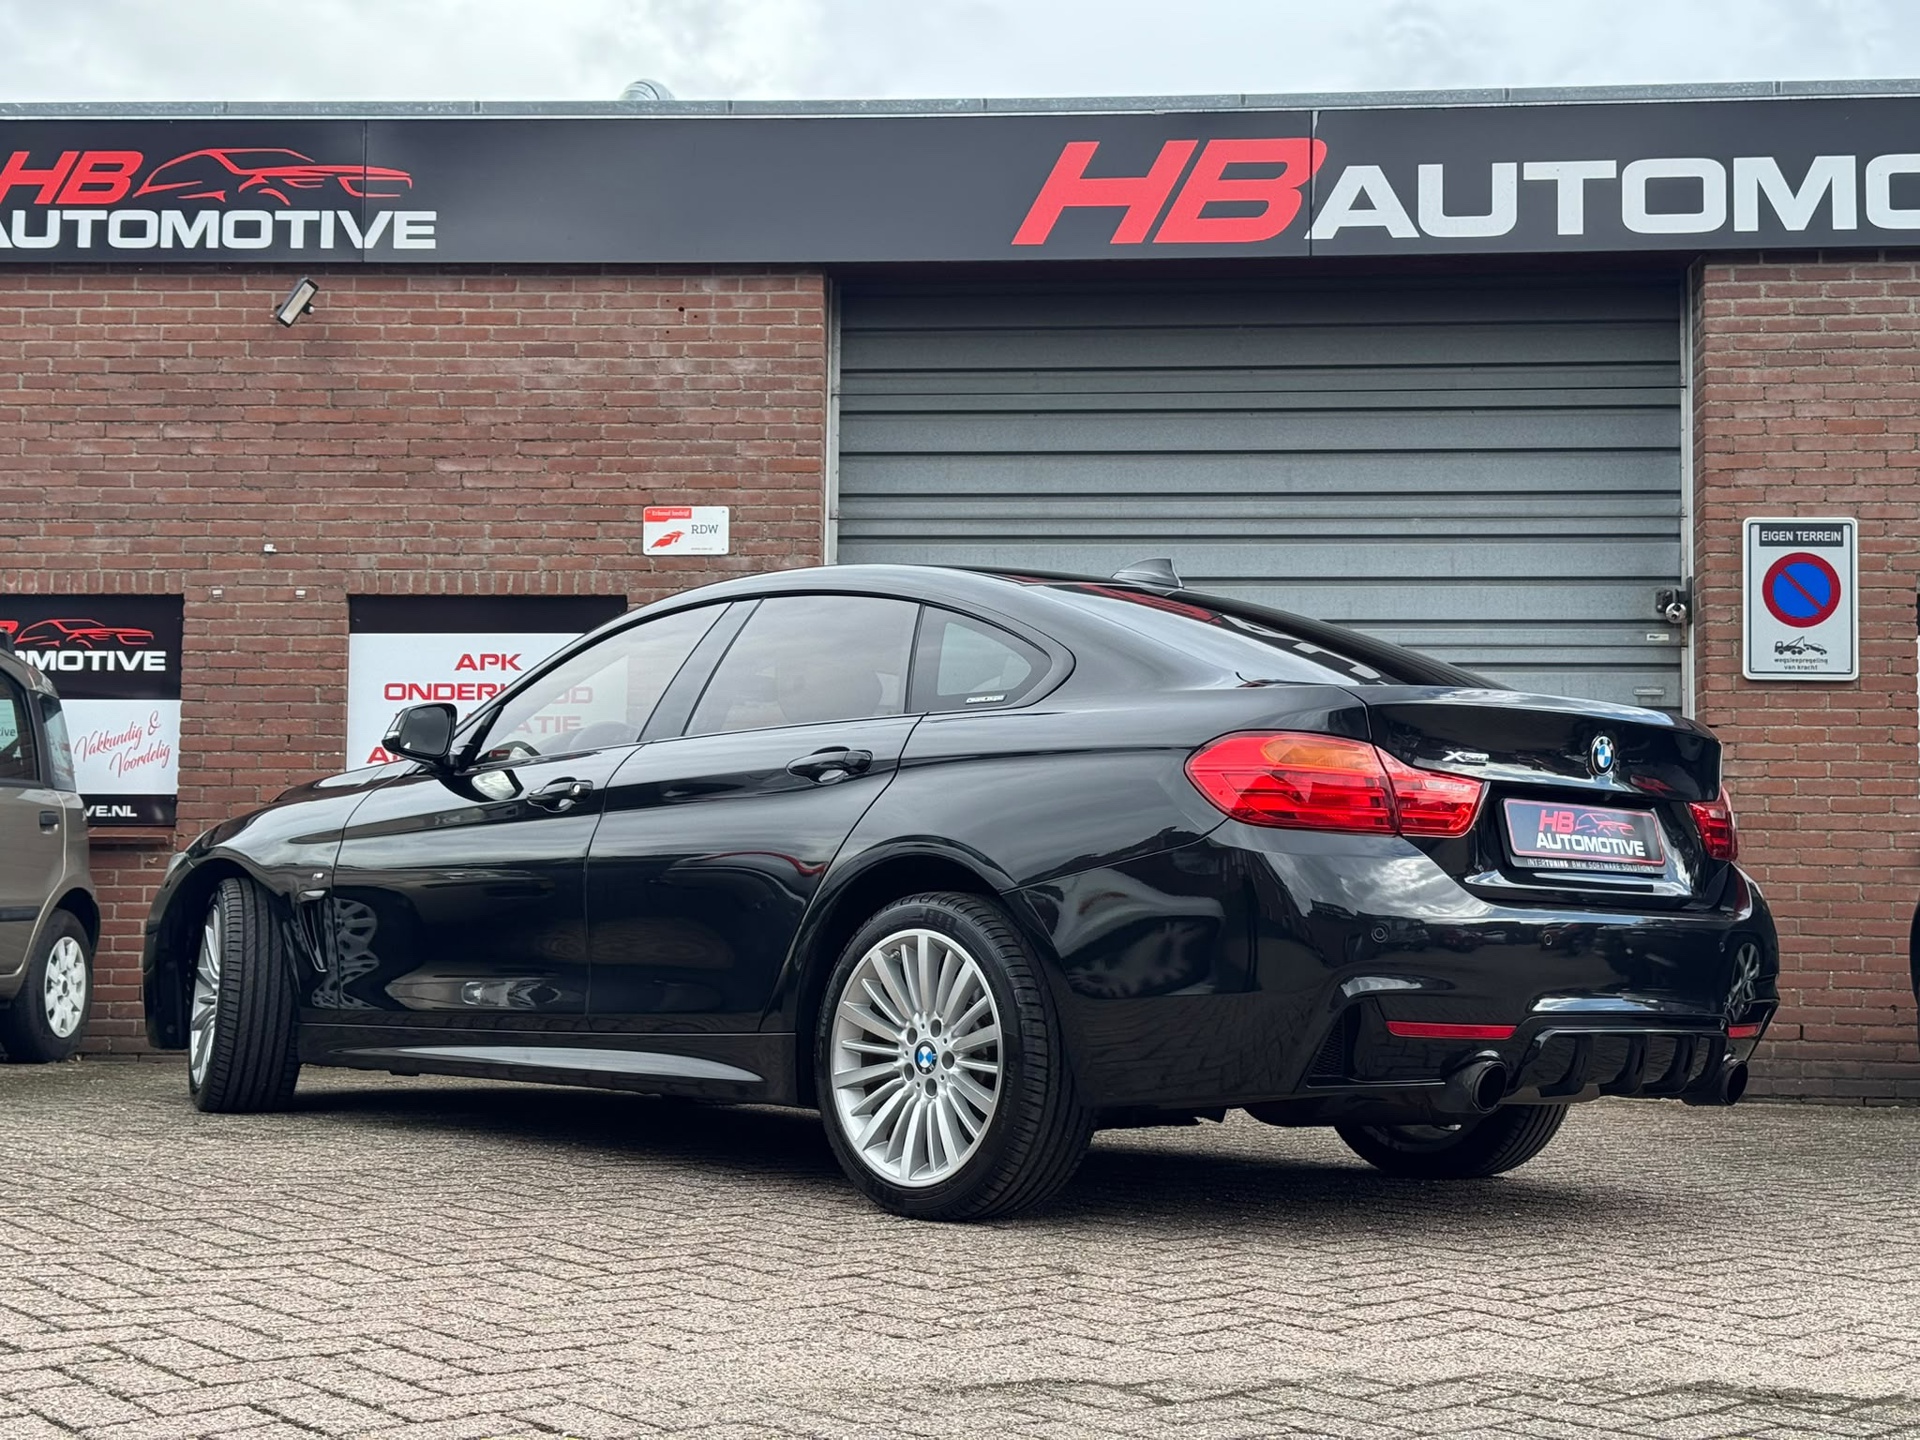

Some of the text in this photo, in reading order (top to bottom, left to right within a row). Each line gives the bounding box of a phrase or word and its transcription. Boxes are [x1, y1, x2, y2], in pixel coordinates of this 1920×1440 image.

[0, 150, 144, 205] HB
[1011, 136, 1327, 246] HB
[691, 524, 719, 535] RDW
[1761, 531, 1842, 542] EIGEN TERREIN
[454, 653, 523, 671] APK
[73, 720, 143, 763] Vakkundig
[109, 740, 171, 778] Voordelig
[1538, 809, 1576, 834] HB
[1536, 832, 1646, 857] AUTOMOTIVE
